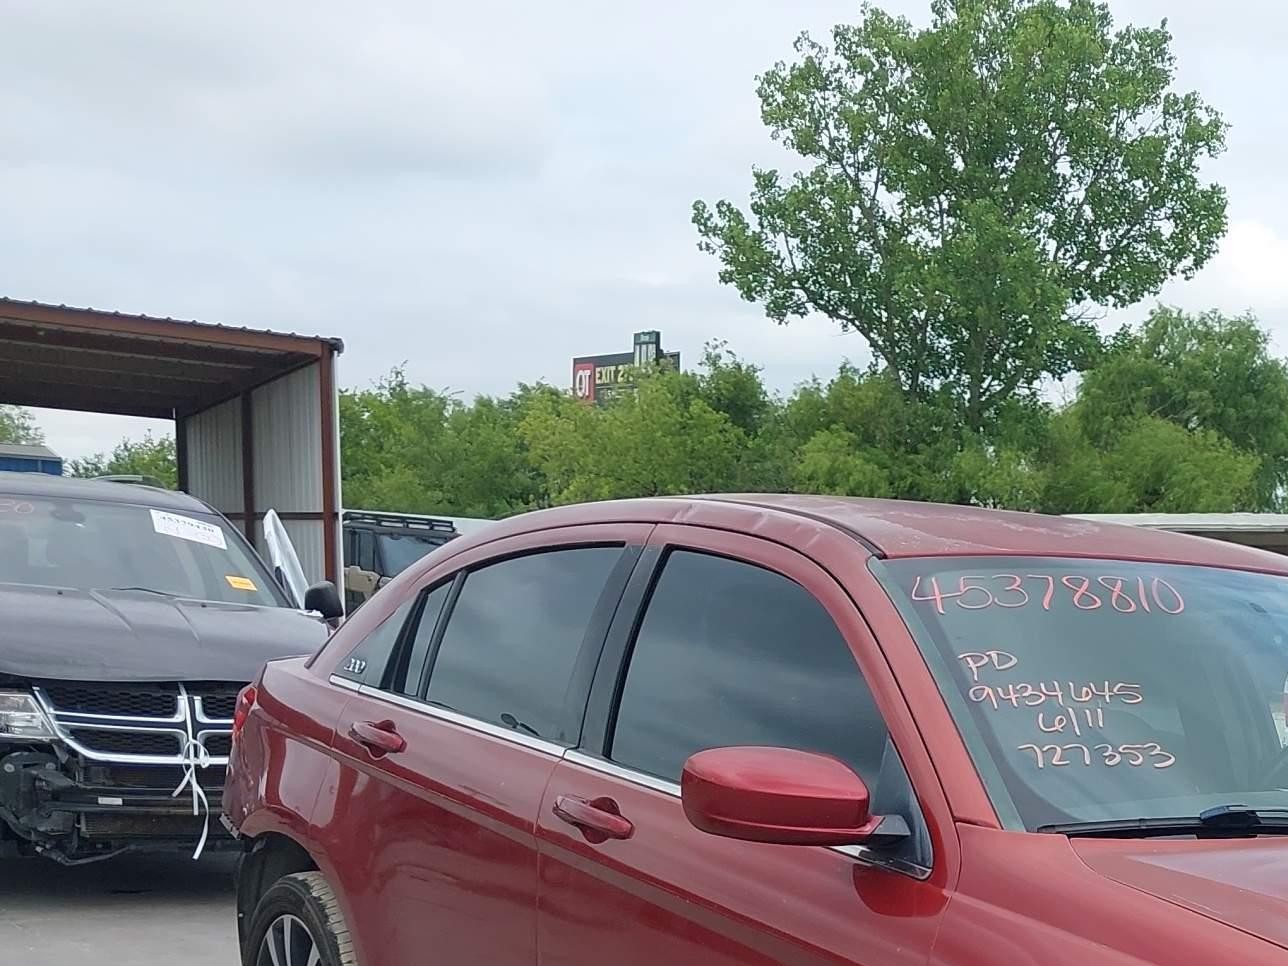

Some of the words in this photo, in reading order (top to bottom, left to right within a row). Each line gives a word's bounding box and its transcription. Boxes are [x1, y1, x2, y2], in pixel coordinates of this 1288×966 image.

[596, 365, 617, 385] EXIT
[911, 574, 1185, 615] 45378810
[957, 650, 1018, 682] PD
[968, 680, 1144, 710] 9434645
[1017, 743, 1176, 769] 727353
